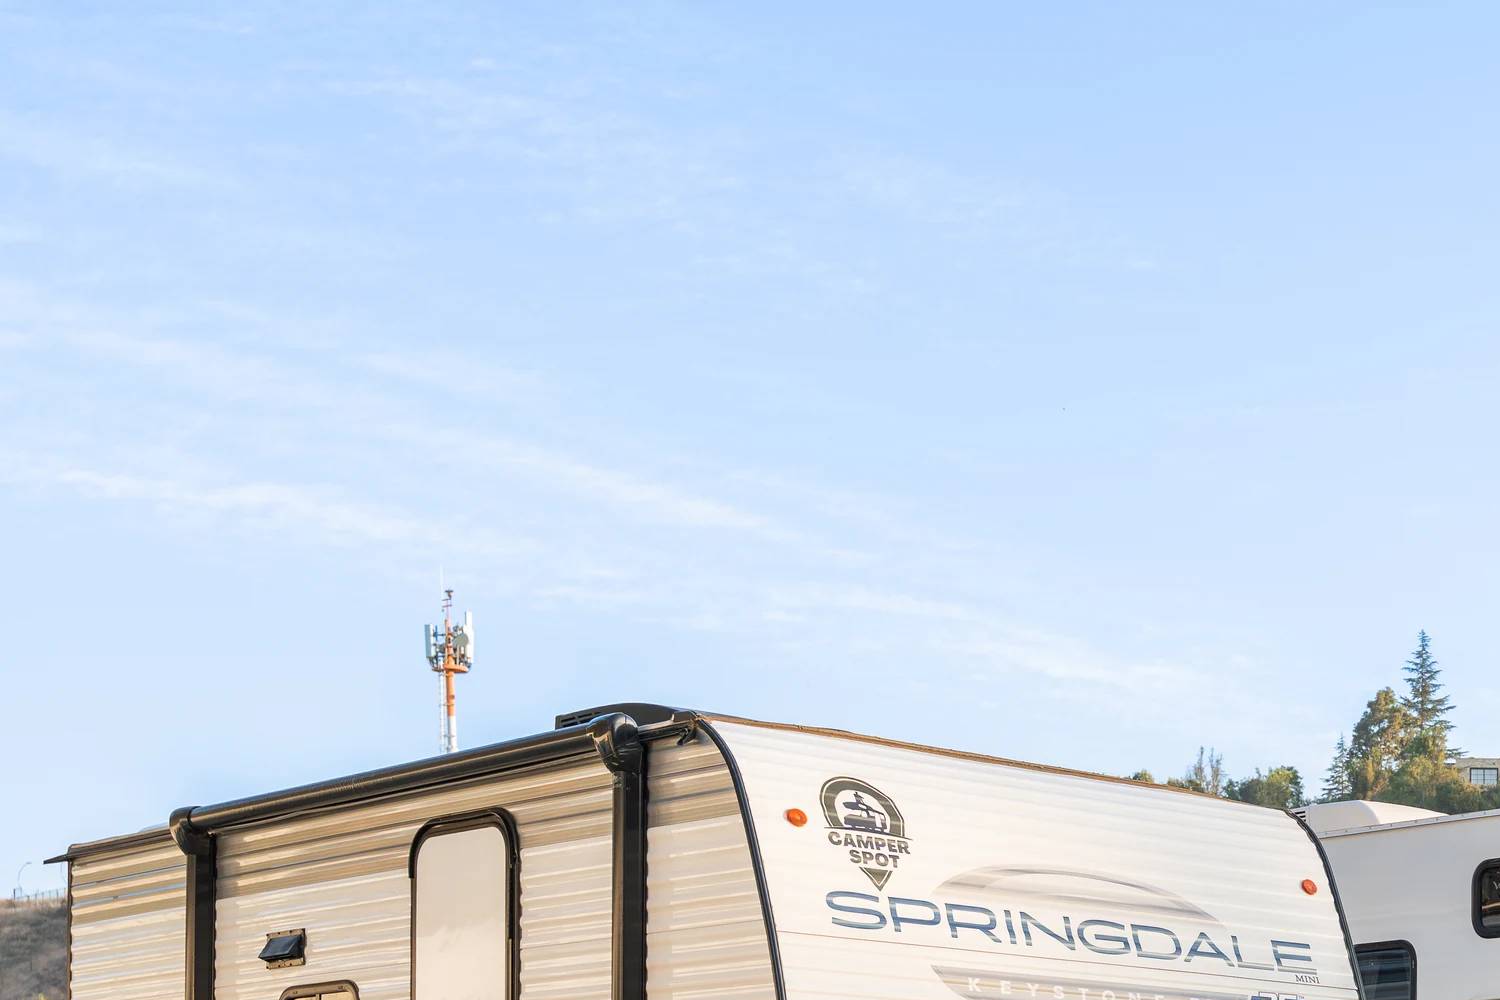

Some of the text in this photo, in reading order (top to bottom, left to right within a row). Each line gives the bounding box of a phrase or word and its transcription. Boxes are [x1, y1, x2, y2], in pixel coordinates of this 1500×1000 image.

[828, 831, 911, 855] CAMPER
[849, 849, 900, 868] SPOT
[826, 890, 1318, 974] SPRINGDALE
[1295, 974, 1321, 984] MINI
